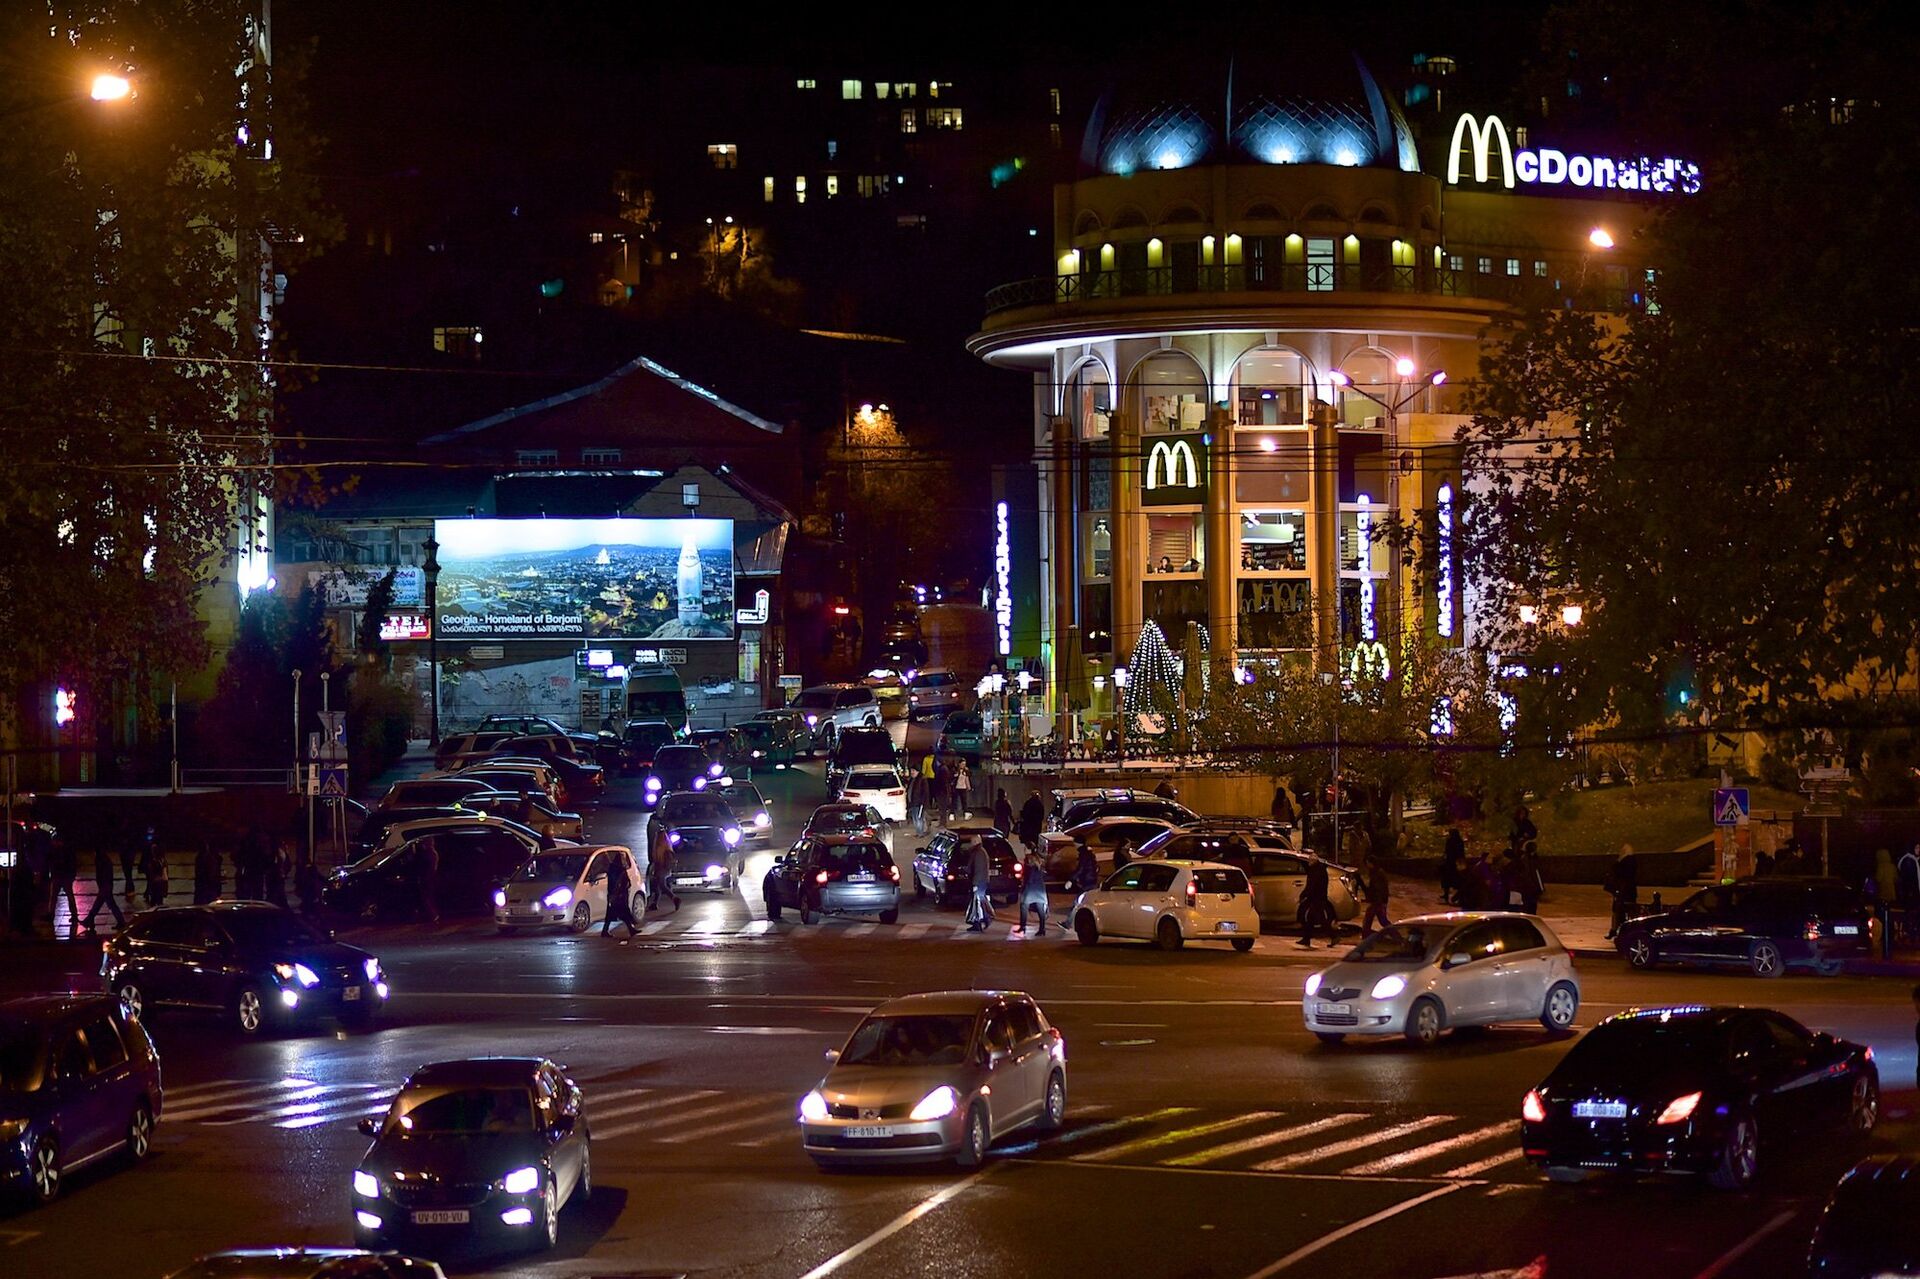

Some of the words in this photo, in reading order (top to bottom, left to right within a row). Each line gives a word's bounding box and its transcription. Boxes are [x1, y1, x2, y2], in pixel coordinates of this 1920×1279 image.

[1447, 112, 1702, 194] McDonald's
[441, 614, 478, 626] Georgia
[485, 614, 532, 624] Homeland
[534, 614, 544, 624] of
[545, 614, 582, 626] Borjomi
